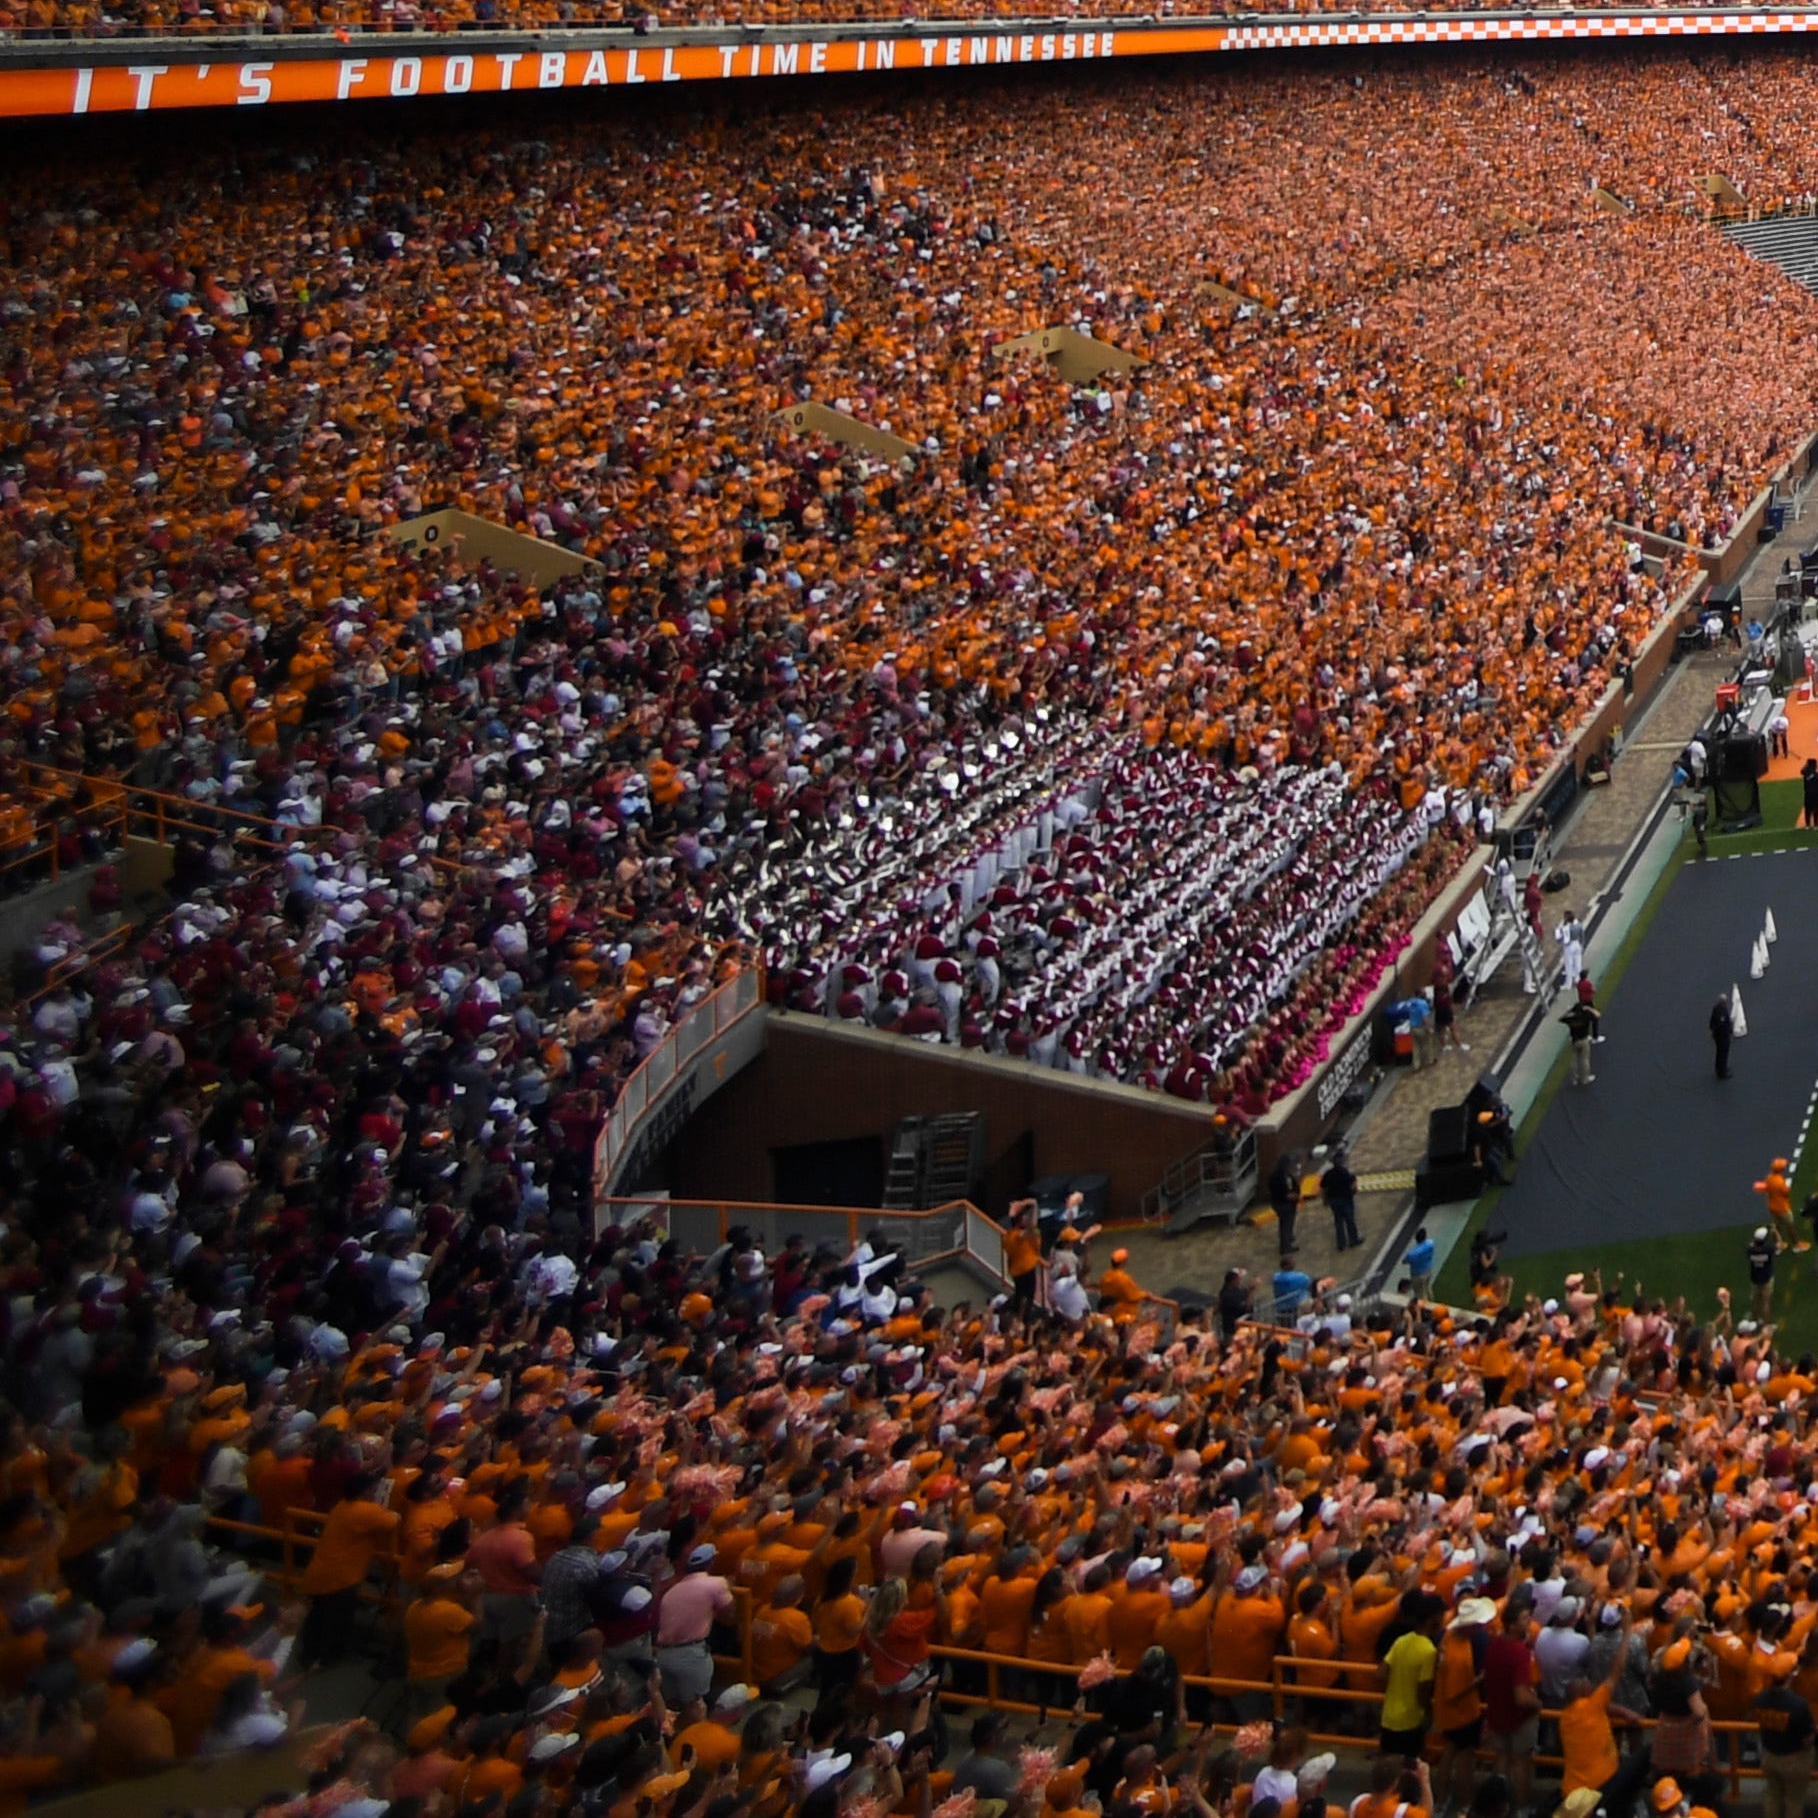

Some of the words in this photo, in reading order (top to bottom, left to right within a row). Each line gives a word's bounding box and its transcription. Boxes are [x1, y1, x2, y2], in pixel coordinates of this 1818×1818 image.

[72, 62, 274, 114] IT'S
[336, 48, 682, 100] FOOTBALL
[718, 42, 828, 78] TIME
[857, 39, 895, 70] IN
[921, 32, 1115, 67] TENNESSEE
[1334, 1022, 1373, 1082] DOMINION
[1320, 1066, 1352, 1121] FREIGHT
